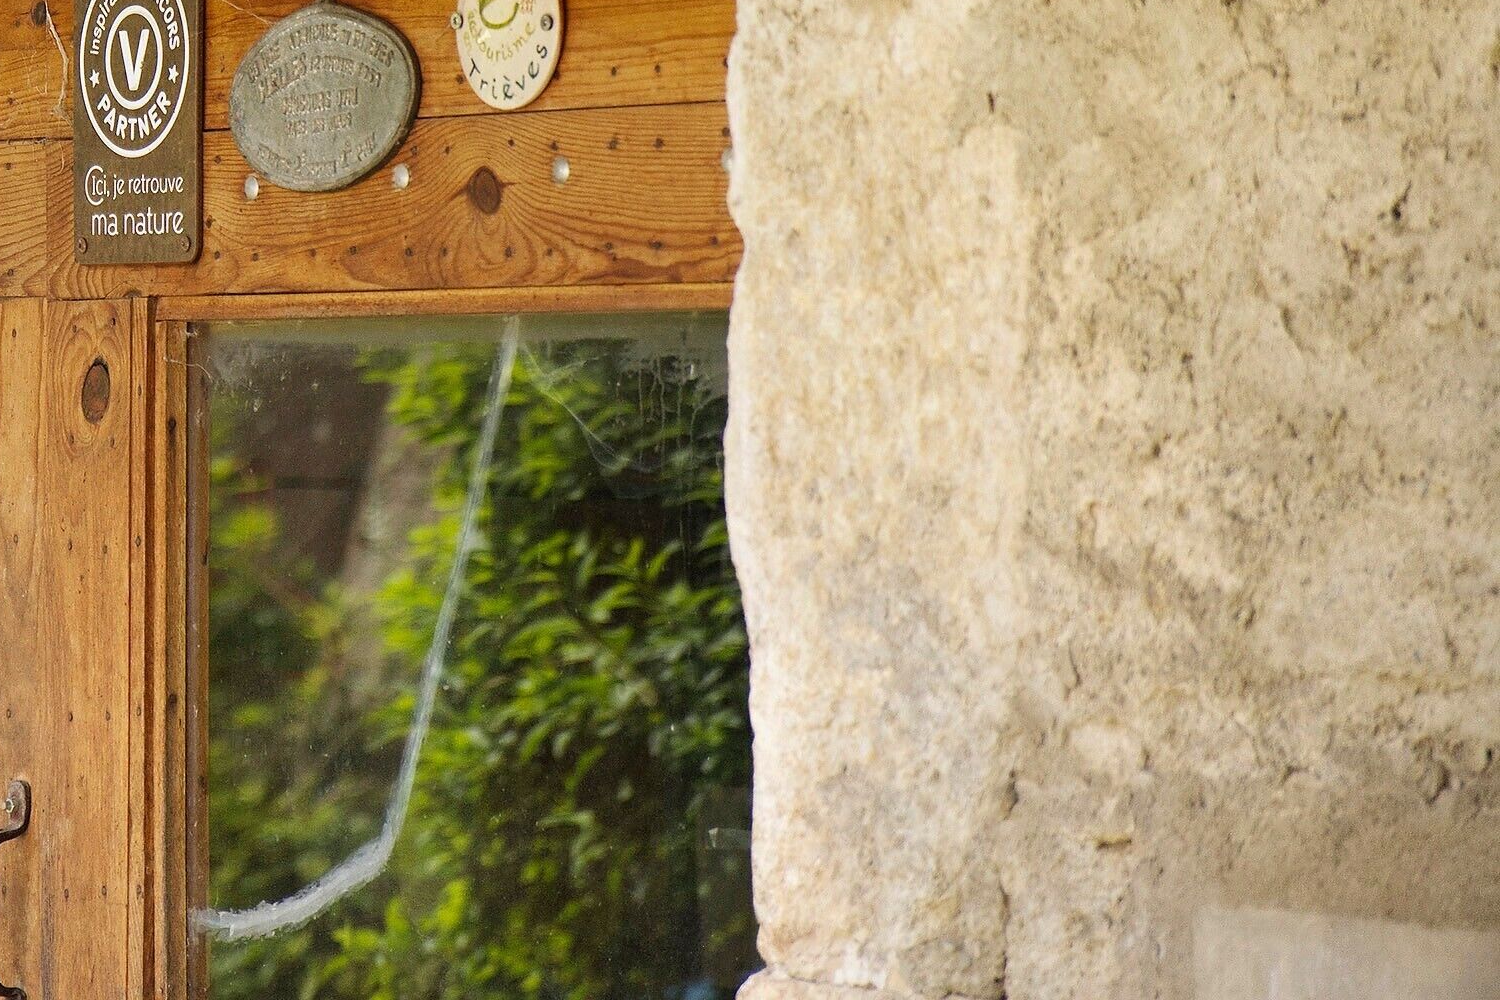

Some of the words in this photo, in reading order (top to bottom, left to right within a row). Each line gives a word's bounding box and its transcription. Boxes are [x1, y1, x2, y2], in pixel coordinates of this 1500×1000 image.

[118, 28, 150, 92] V
[469, 43, 549, 101] Trièves
[96, 89, 173, 142] PARTNER
[112, 177, 126, 201] je
[128, 174, 185, 195] retrouve
[91, 211, 118, 237] ma
[123, 209, 185, 236] nature
